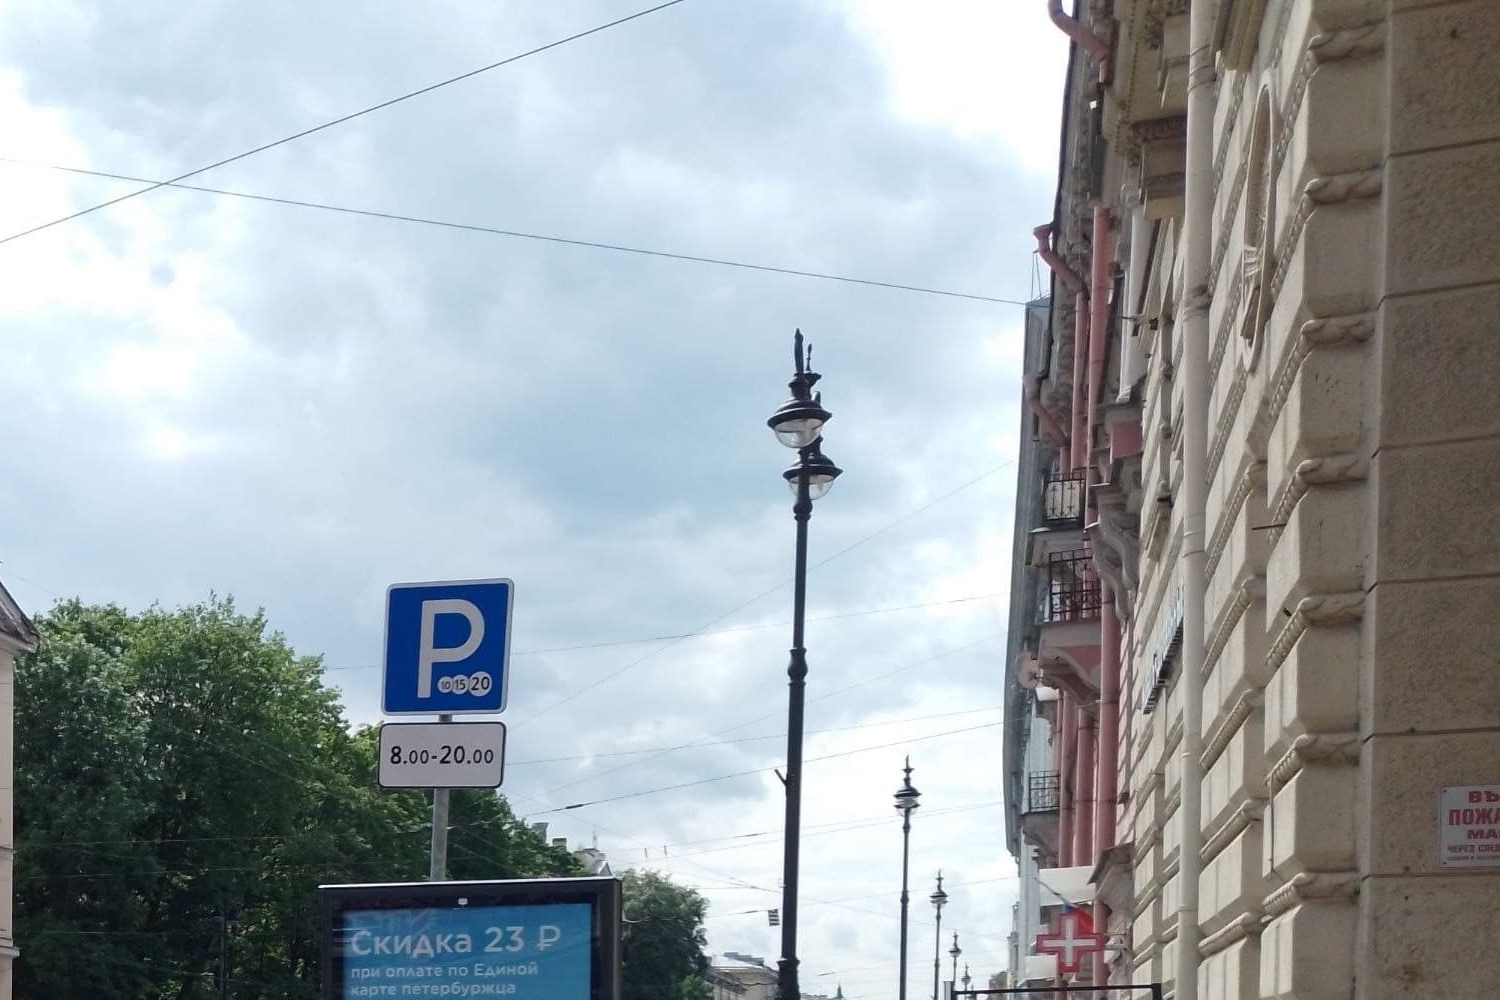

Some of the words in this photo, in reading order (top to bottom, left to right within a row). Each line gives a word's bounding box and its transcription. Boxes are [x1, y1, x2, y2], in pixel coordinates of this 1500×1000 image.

[417, 599, 485, 698] P
[455, 678, 466, 690] 15
[471, 676, 490, 691] 20
[390, 745, 494, 765] 8.00-20.00
[1468, 829, 1500, 840] МА
[352, 930, 472, 958] Скидка
[485, 926, 525, 953] 23
[352, 967, 381, 979] при
[386, 965, 443, 978] оплате
[448, 964, 468, 976] по
[474, 962, 539, 977] Единой
[352, 984, 397, 998] карте
[402, 982, 516, 997] петербуржца
